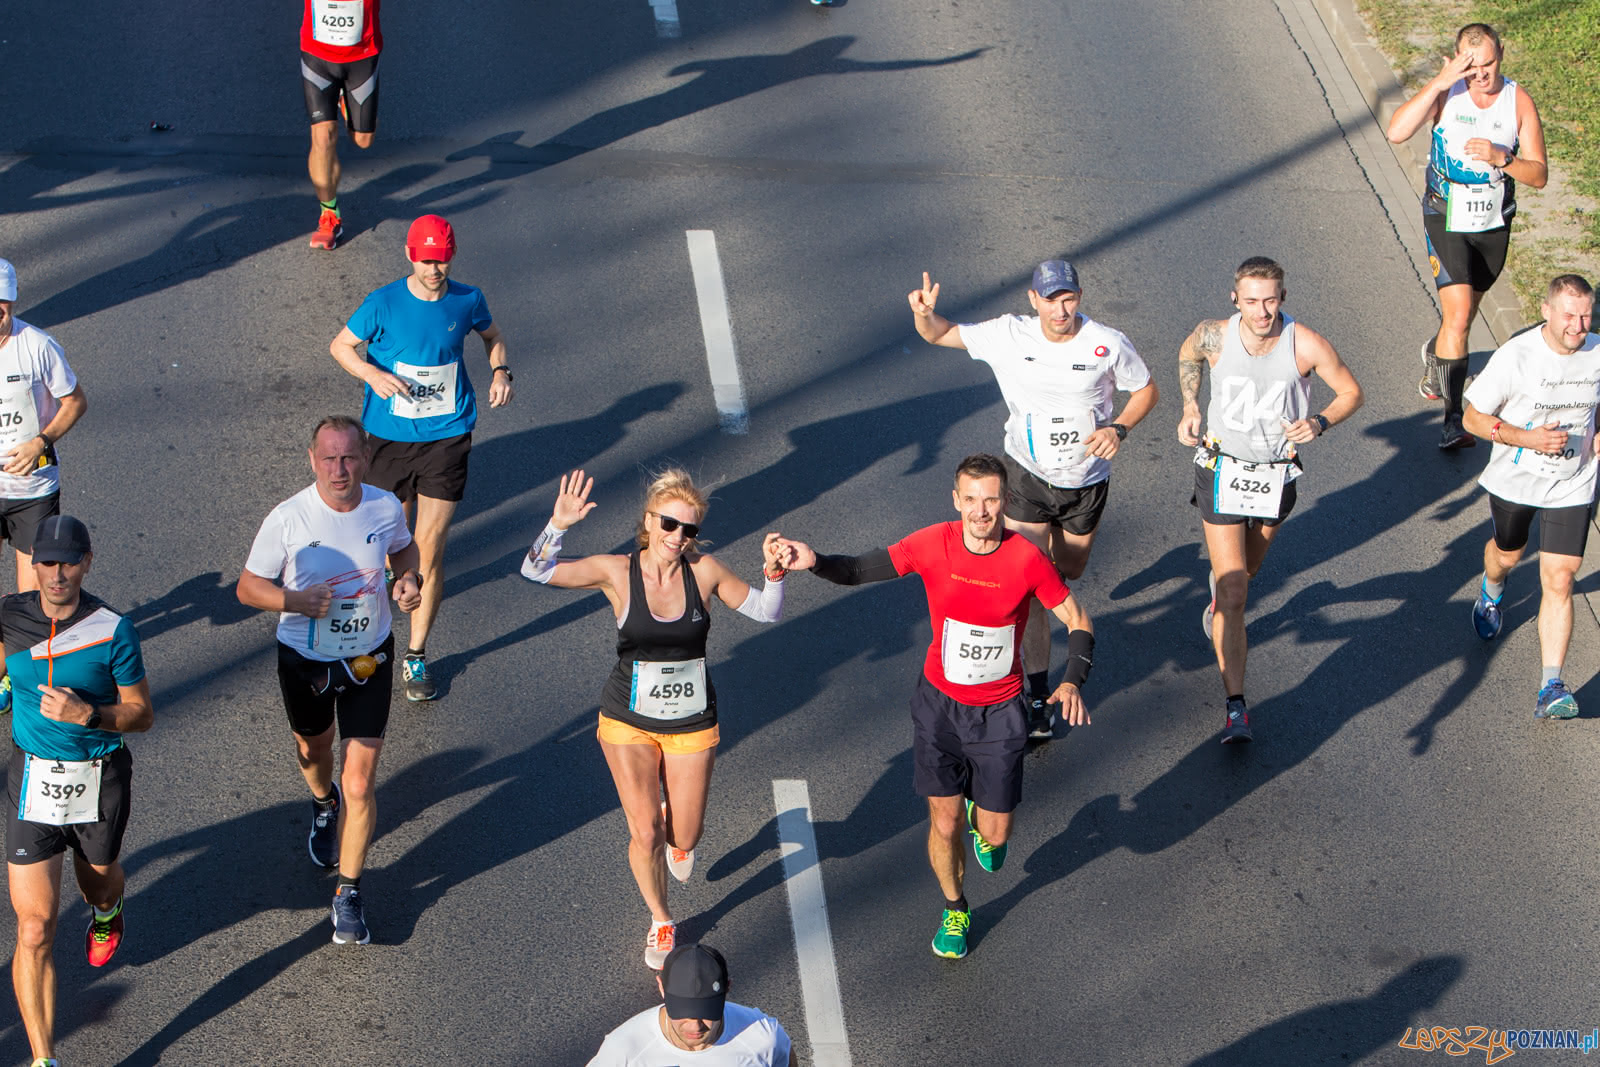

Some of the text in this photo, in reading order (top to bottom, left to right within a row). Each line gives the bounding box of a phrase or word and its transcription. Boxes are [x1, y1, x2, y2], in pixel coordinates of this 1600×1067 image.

[321, 15, 355, 27] 4203
[1466, 200, 1493, 212] 1116
[409, 382, 446, 398] 4854
[1050, 431, 1080, 446] 592
[1230, 477, 1271, 494] 4326
[330, 617, 370, 634] 5619
[959, 643, 1004, 661] 5877
[649, 682, 695, 699] 4598
[41, 781, 87, 800] 3399
